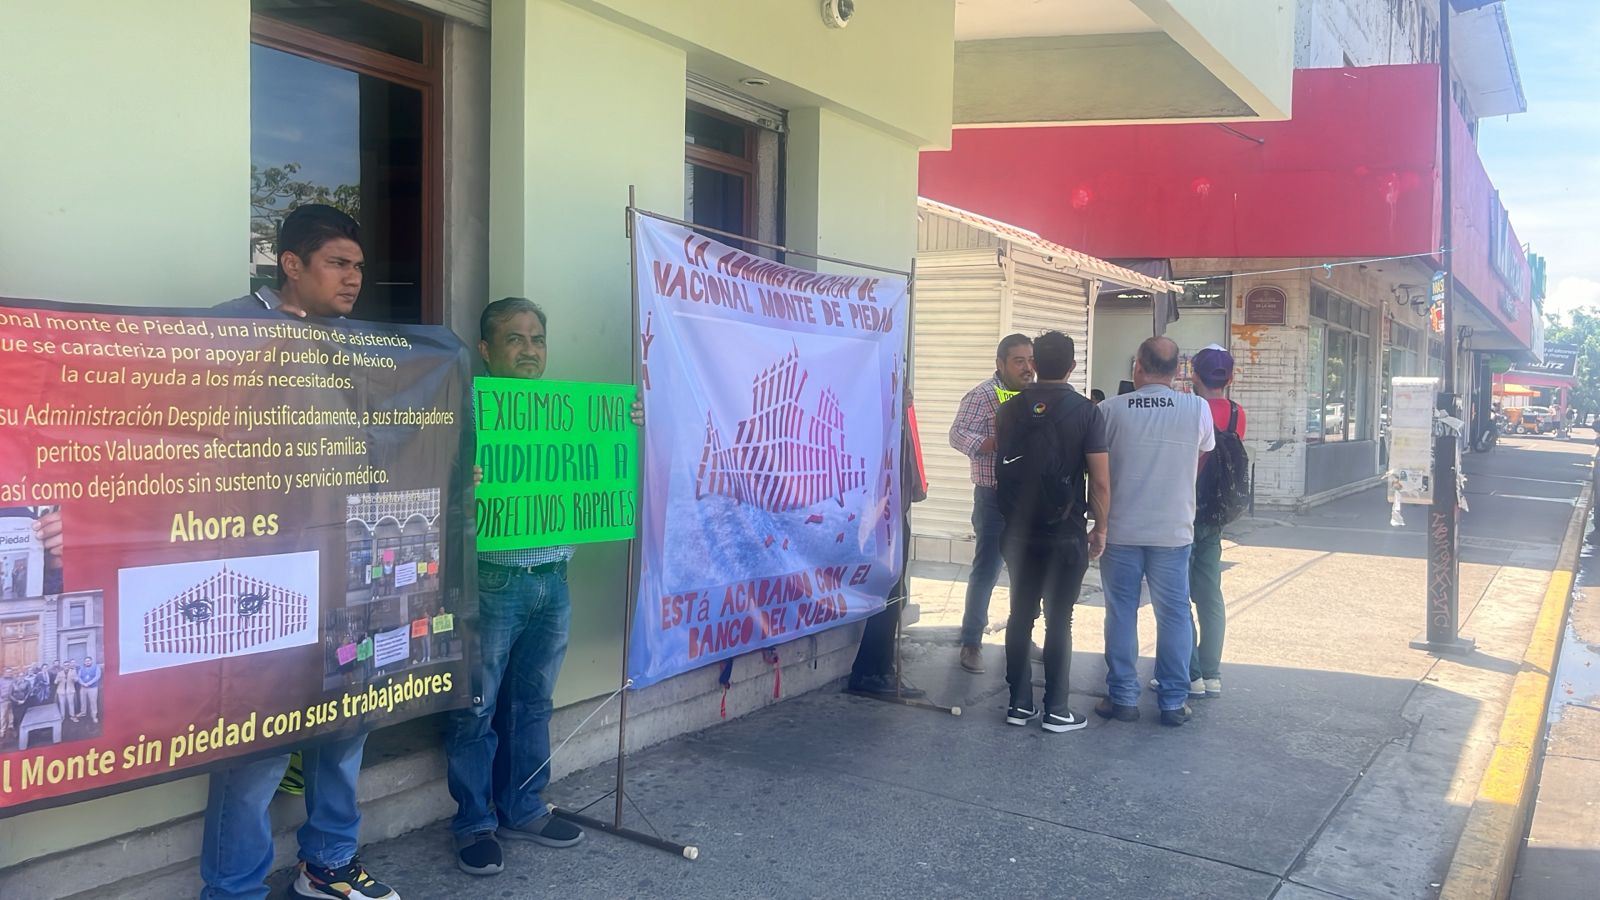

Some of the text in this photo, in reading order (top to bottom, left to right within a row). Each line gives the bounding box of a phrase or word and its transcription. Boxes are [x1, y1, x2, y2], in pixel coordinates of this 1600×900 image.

[684, 235, 711, 270] LA
[858, 278, 880, 303] DE
[653, 260, 754, 314] NACIONAL
[757, 288, 816, 324] MONTE
[821, 299, 844, 327] DE
[47, 317, 111, 332] monte
[116, 318, 139, 334] de
[144, 319, 214, 339] Piedad,
[217, 325, 249, 337] una
[252, 322, 330, 341] institucion
[331, 329, 346, 343] de
[349, 330, 413, 350] asistencia,
[33, 341, 56, 354] se
[61, 341, 167, 359] caracteriza
[172, 346, 200, 363] por
[205, 348, 264, 366] apoyar
[263, 346, 276, 362] al
[280, 347, 329, 366] pueblo
[332, 350, 350, 366] de
[353, 352, 397, 371] México,
[61, 364, 355, 389] la cual ayuda a los más necesitados.
[0, 402, 454, 431] su Administración Despide injustificadamente, a sus trabajadores
[478, 390, 625, 432] EXIGIMOS UNA
[1128, 397, 1174, 409] PRENSA
[37, 436, 367, 468] peritos Valuadores afectando a sus Familias
[480, 442, 628, 484] AUDITORIA A
[1, 464, 389, 503] así como dejándolos sin sustento y servicio médico.
[170, 510, 279, 543] Ahora es
[475, 490, 635, 538] DIRECTIVOS RAPACES
[720, 569, 813, 618] ACABANDO
[815, 565, 848, 593] CON
[849, 564, 872, 586] EL
[688, 593, 847, 660] BANCO DEL PUEBLO
[21, 748, 116, 790] Monte
[122, 734, 162, 769] sin
[169, 712, 256, 767] piedad
[262, 710, 302, 738] con
[305, 699, 338, 728] sus
[342, 672, 453, 718] trabajadores
